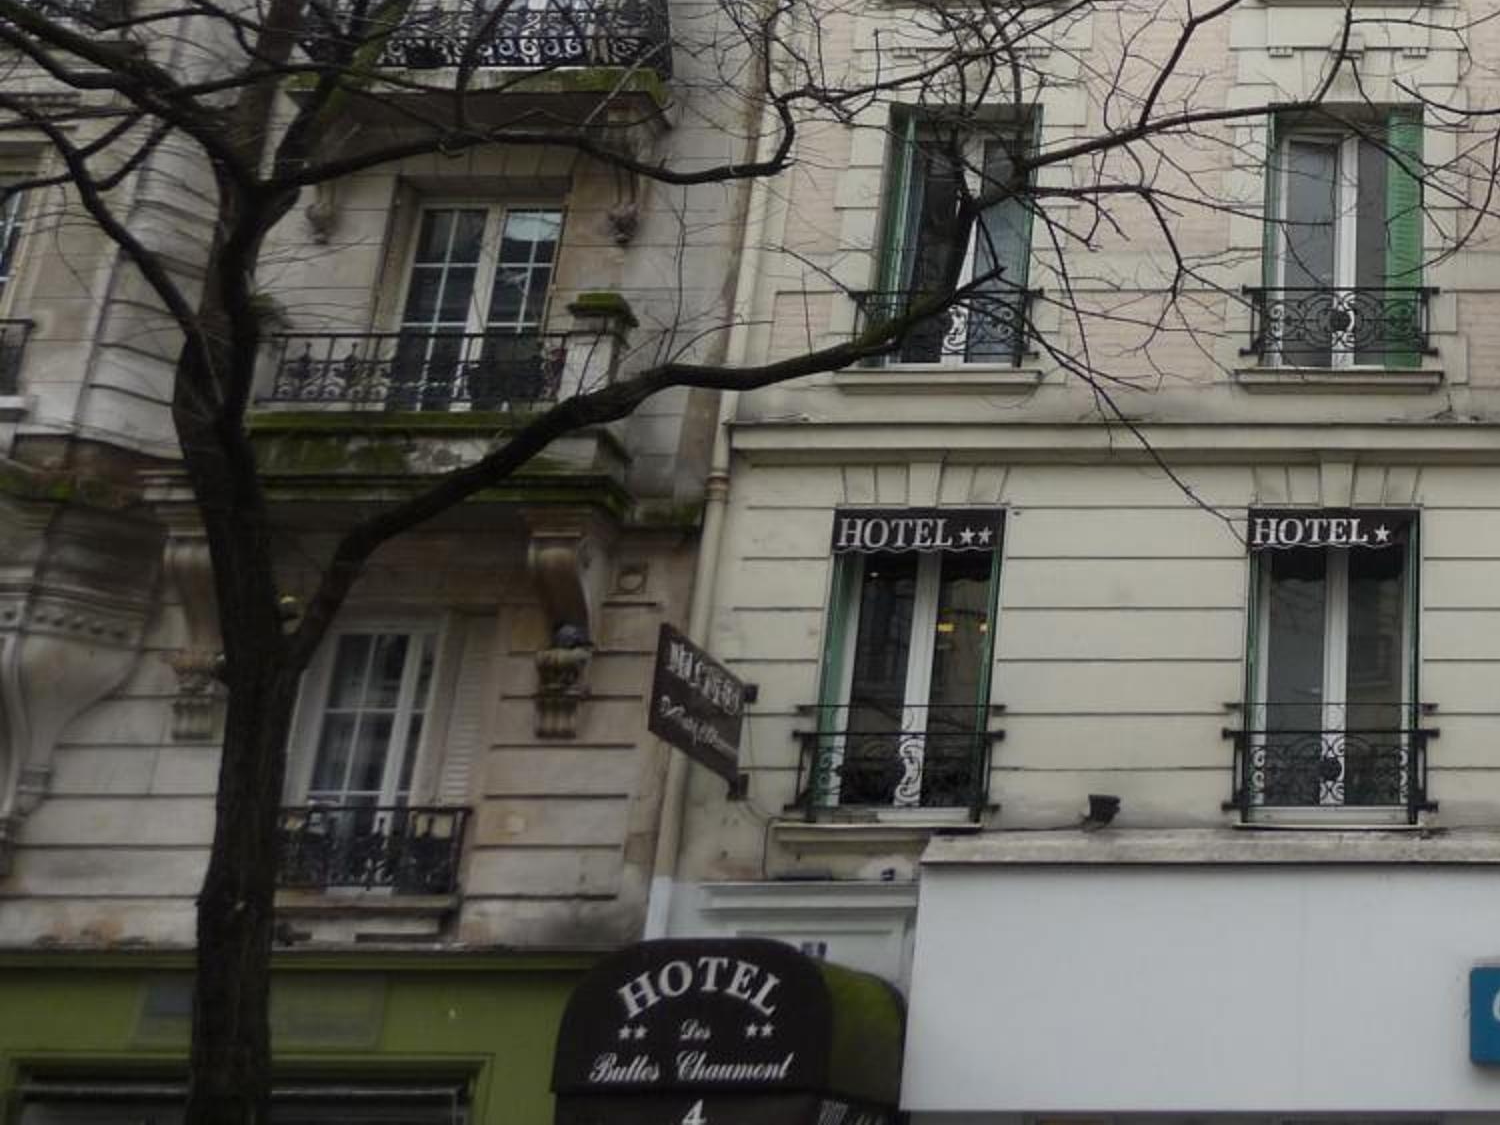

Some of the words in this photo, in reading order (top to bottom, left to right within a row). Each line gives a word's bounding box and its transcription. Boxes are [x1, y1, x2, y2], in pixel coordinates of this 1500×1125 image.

[836, 517, 953, 548] HOTEL
[1252, 517, 1369, 545] HOTEL
[616, 955, 782, 1020] HOTEL
[675, 1049, 795, 1081] Chaumont
